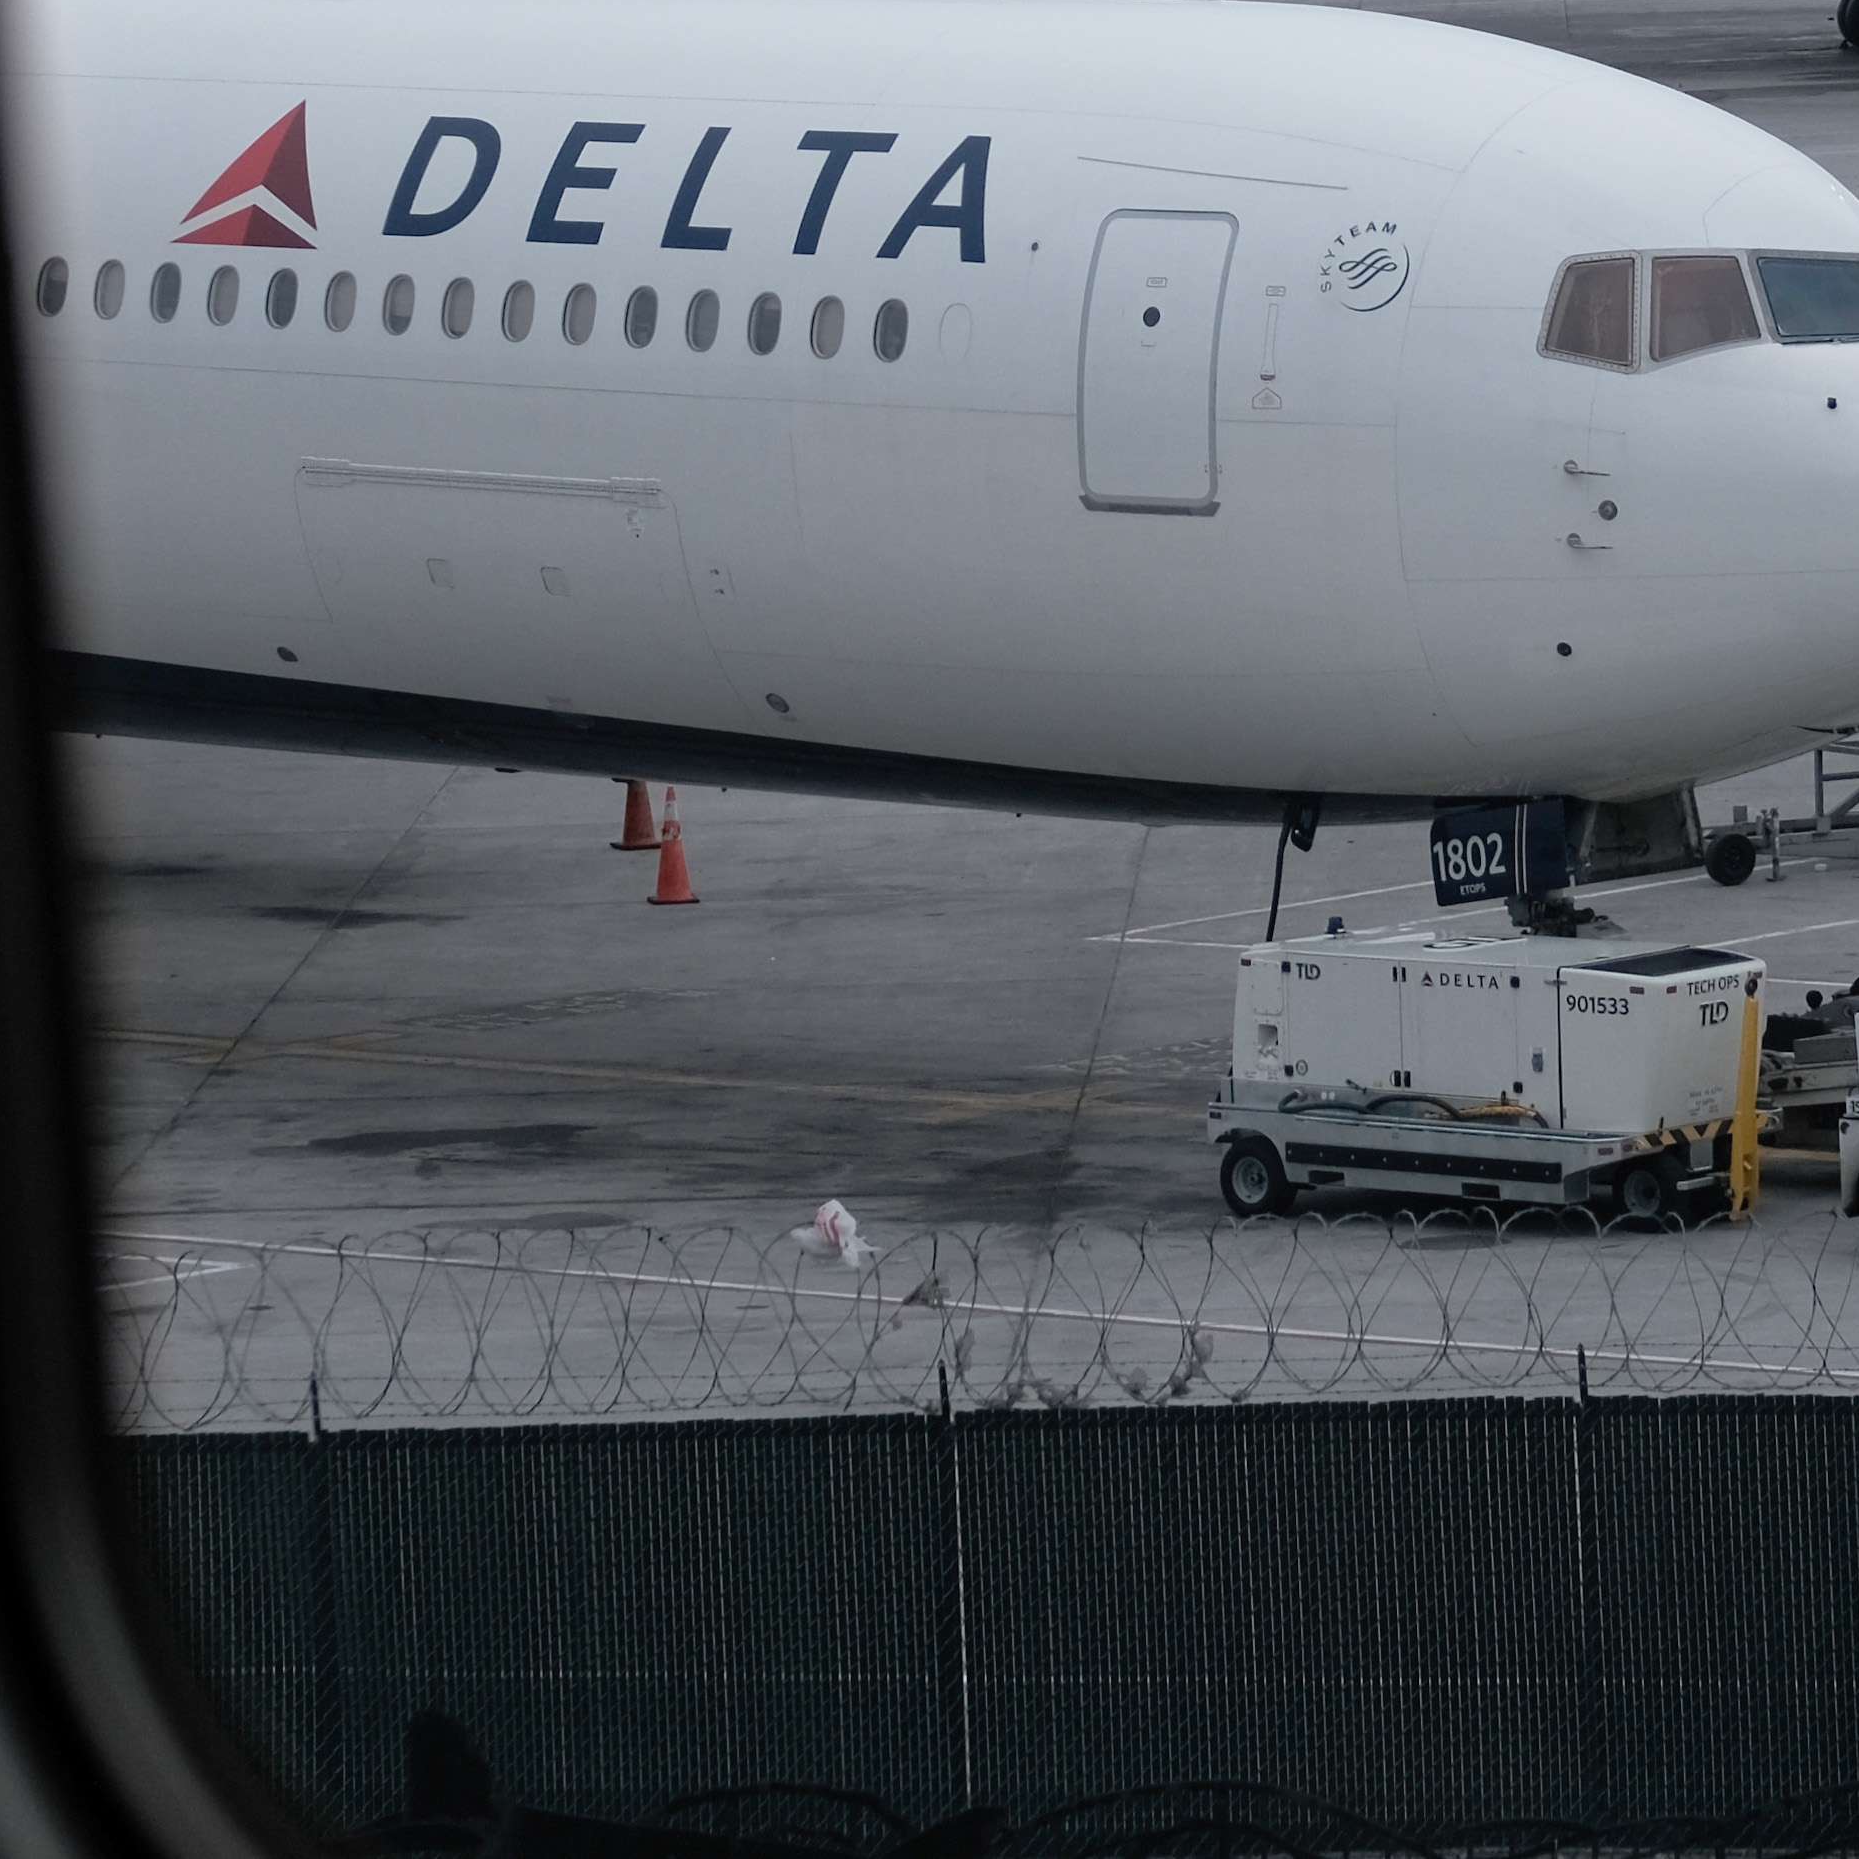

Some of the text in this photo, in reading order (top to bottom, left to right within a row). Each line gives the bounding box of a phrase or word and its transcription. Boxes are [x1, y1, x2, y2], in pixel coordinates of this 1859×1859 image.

[382, 115, 993, 265] DELTA
[1432, 832, 1507, 882] 1802
[1459, 882, 1486, 896] ETOPS
[1296, 963, 1321, 980] TLD
[1439, 972, 1500, 989] DELTA
[1686, 974, 1741, 997] TECH OPS
[1565, 993, 1630, 1017] 901533
[1699, 1001, 1729, 1027] TLD
